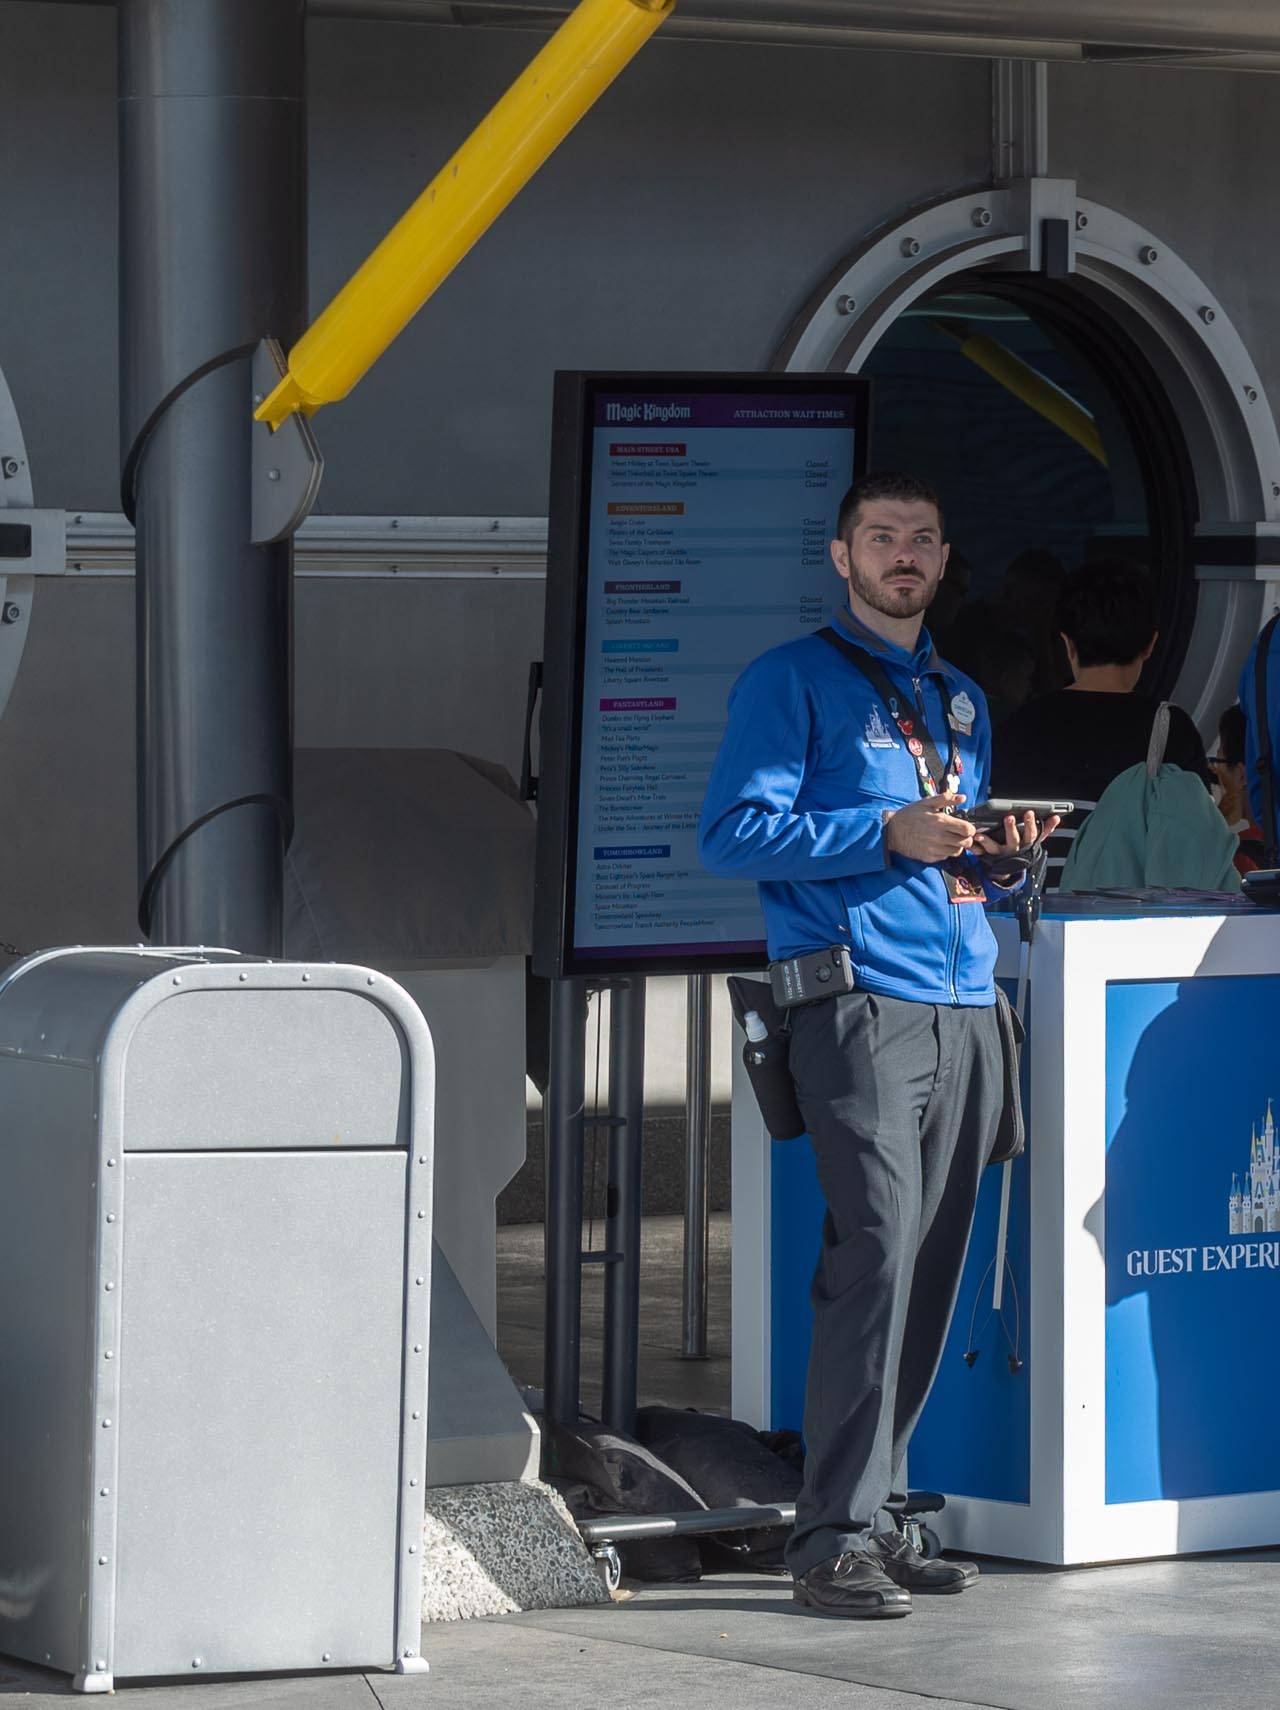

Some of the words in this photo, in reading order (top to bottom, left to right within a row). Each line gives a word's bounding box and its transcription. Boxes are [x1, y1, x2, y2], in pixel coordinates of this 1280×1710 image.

[606, 402, 642, 421] Magic
[643, 402, 691, 421] Kingdom
[734, 409, 790, 419] ATTRACTION
[791, 409, 815, 419] WAIT
[817, 409, 845, 419] TIMES
[616, 446, 636, 454] MAIN
[615, 504, 678, 512] ADVENTURELAND
[615, 583, 671, 591] FRONTIERLAND
[613, 700, 664, 708] FANTASYLAND
[602, 848, 662, 856] TOMORROWLAND
[1127, 1248, 1197, 1276] GUEST
